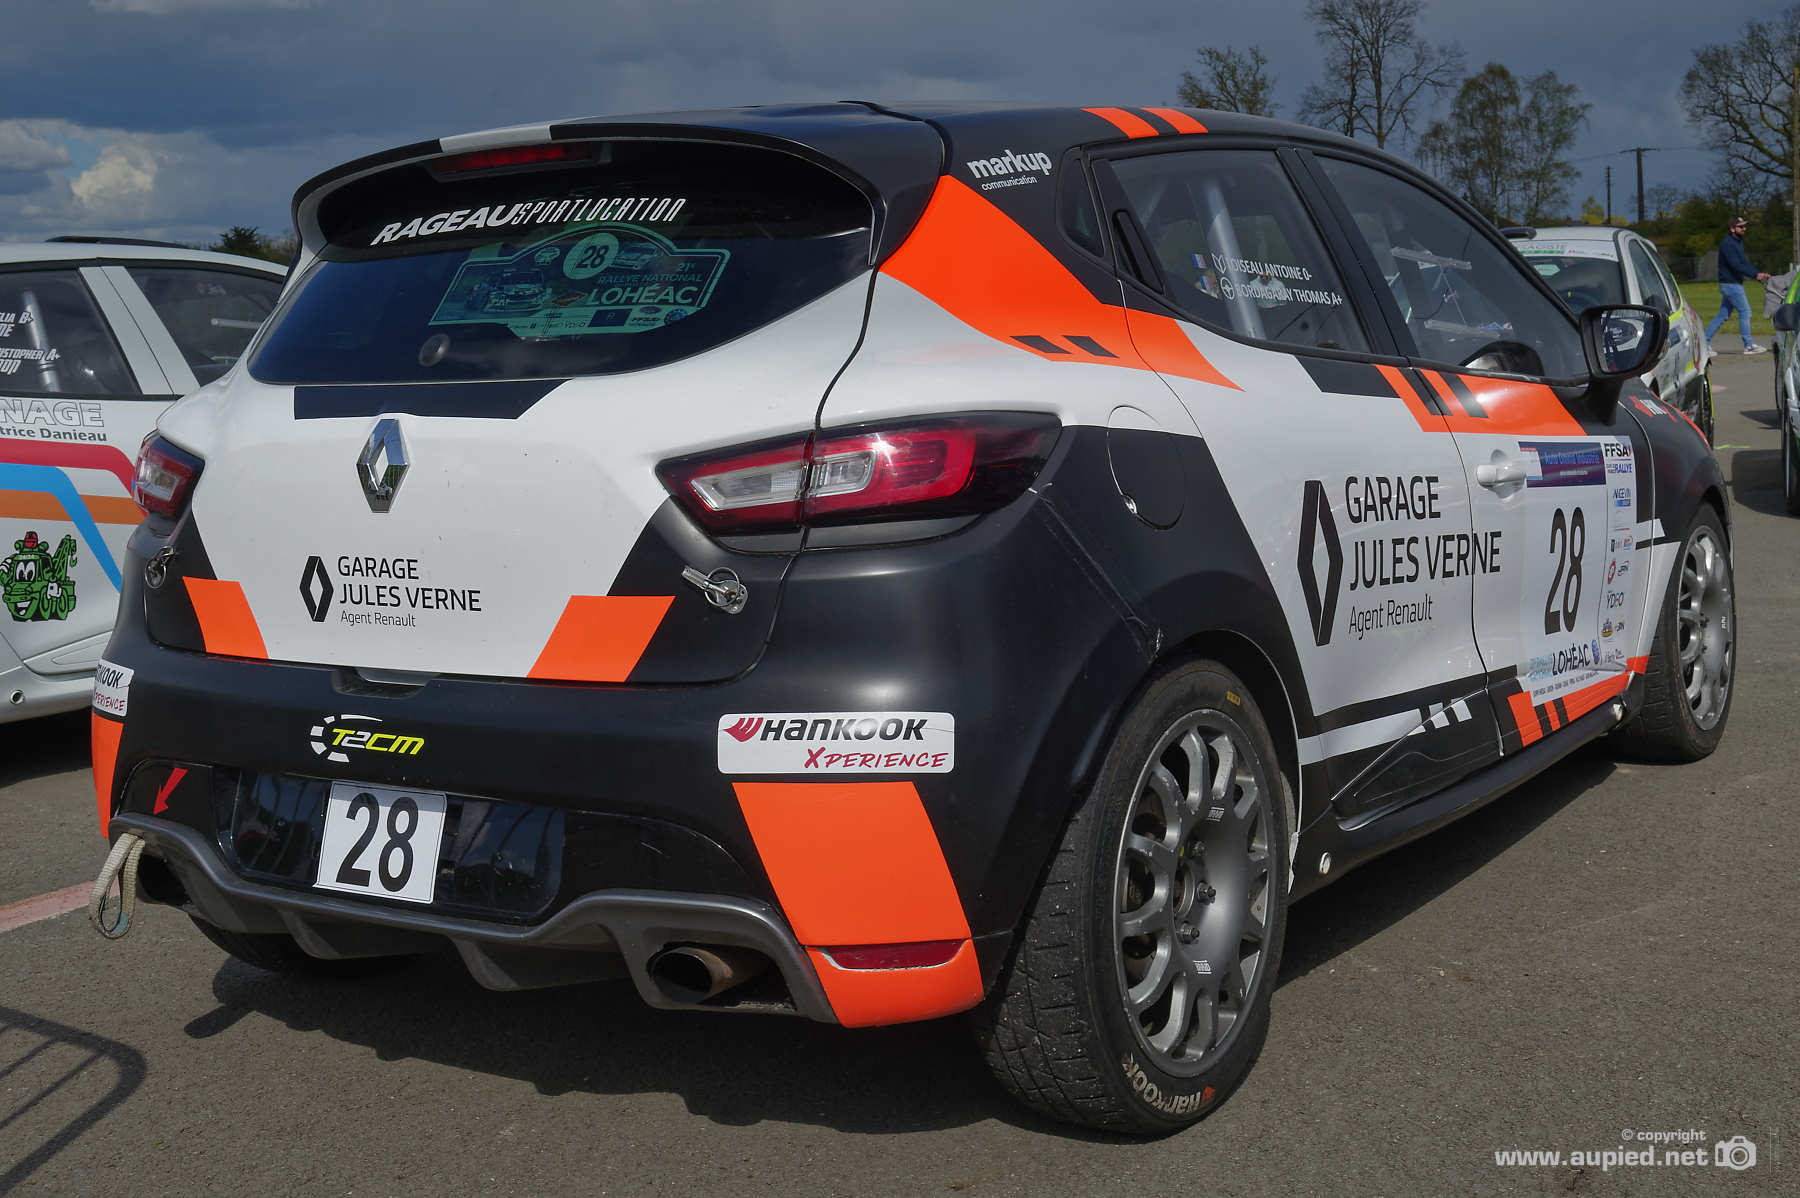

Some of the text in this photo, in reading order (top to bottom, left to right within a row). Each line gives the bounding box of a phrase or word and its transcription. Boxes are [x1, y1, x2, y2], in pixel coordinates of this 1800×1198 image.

[966, 149, 1053, 180] markup
[981, 175, 1038, 191] communication
[371, 198, 687, 245] RAGEAU SPORTLOCATION
[575, 244, 610, 269] 28
[642, 273, 704, 283] NATIONAL
[1264, 263, 1304, 280] ANTOINE
[586, 283, 698, 306] LOHÉAC
[1292, 288, 1334, 304] THOMAS
[46, 348, 61, 361] A+
[40, 428, 107, 441] Danieau
[1603, 443, 1629, 458] FFSA
[1345, 475, 1441, 524] GARAGE
[337, 555, 419, 580] GARAGE
[1350, 531, 1502, 591] JULES VERNE
[1544, 506, 1586, 635] 28
[339, 583, 482, 612] JULES VERNE
[340, 610, 416, 628] Agent Renault
[1348, 593, 1433, 640] Agent Renault
[1552, 643, 1591, 676] LOHÉAC
[332, 728, 425, 755] T2CM
[760, 718, 928, 741] HANKOOK
[804, 747, 949, 769] XPERIENCE
[335, 792, 419, 893] 28
